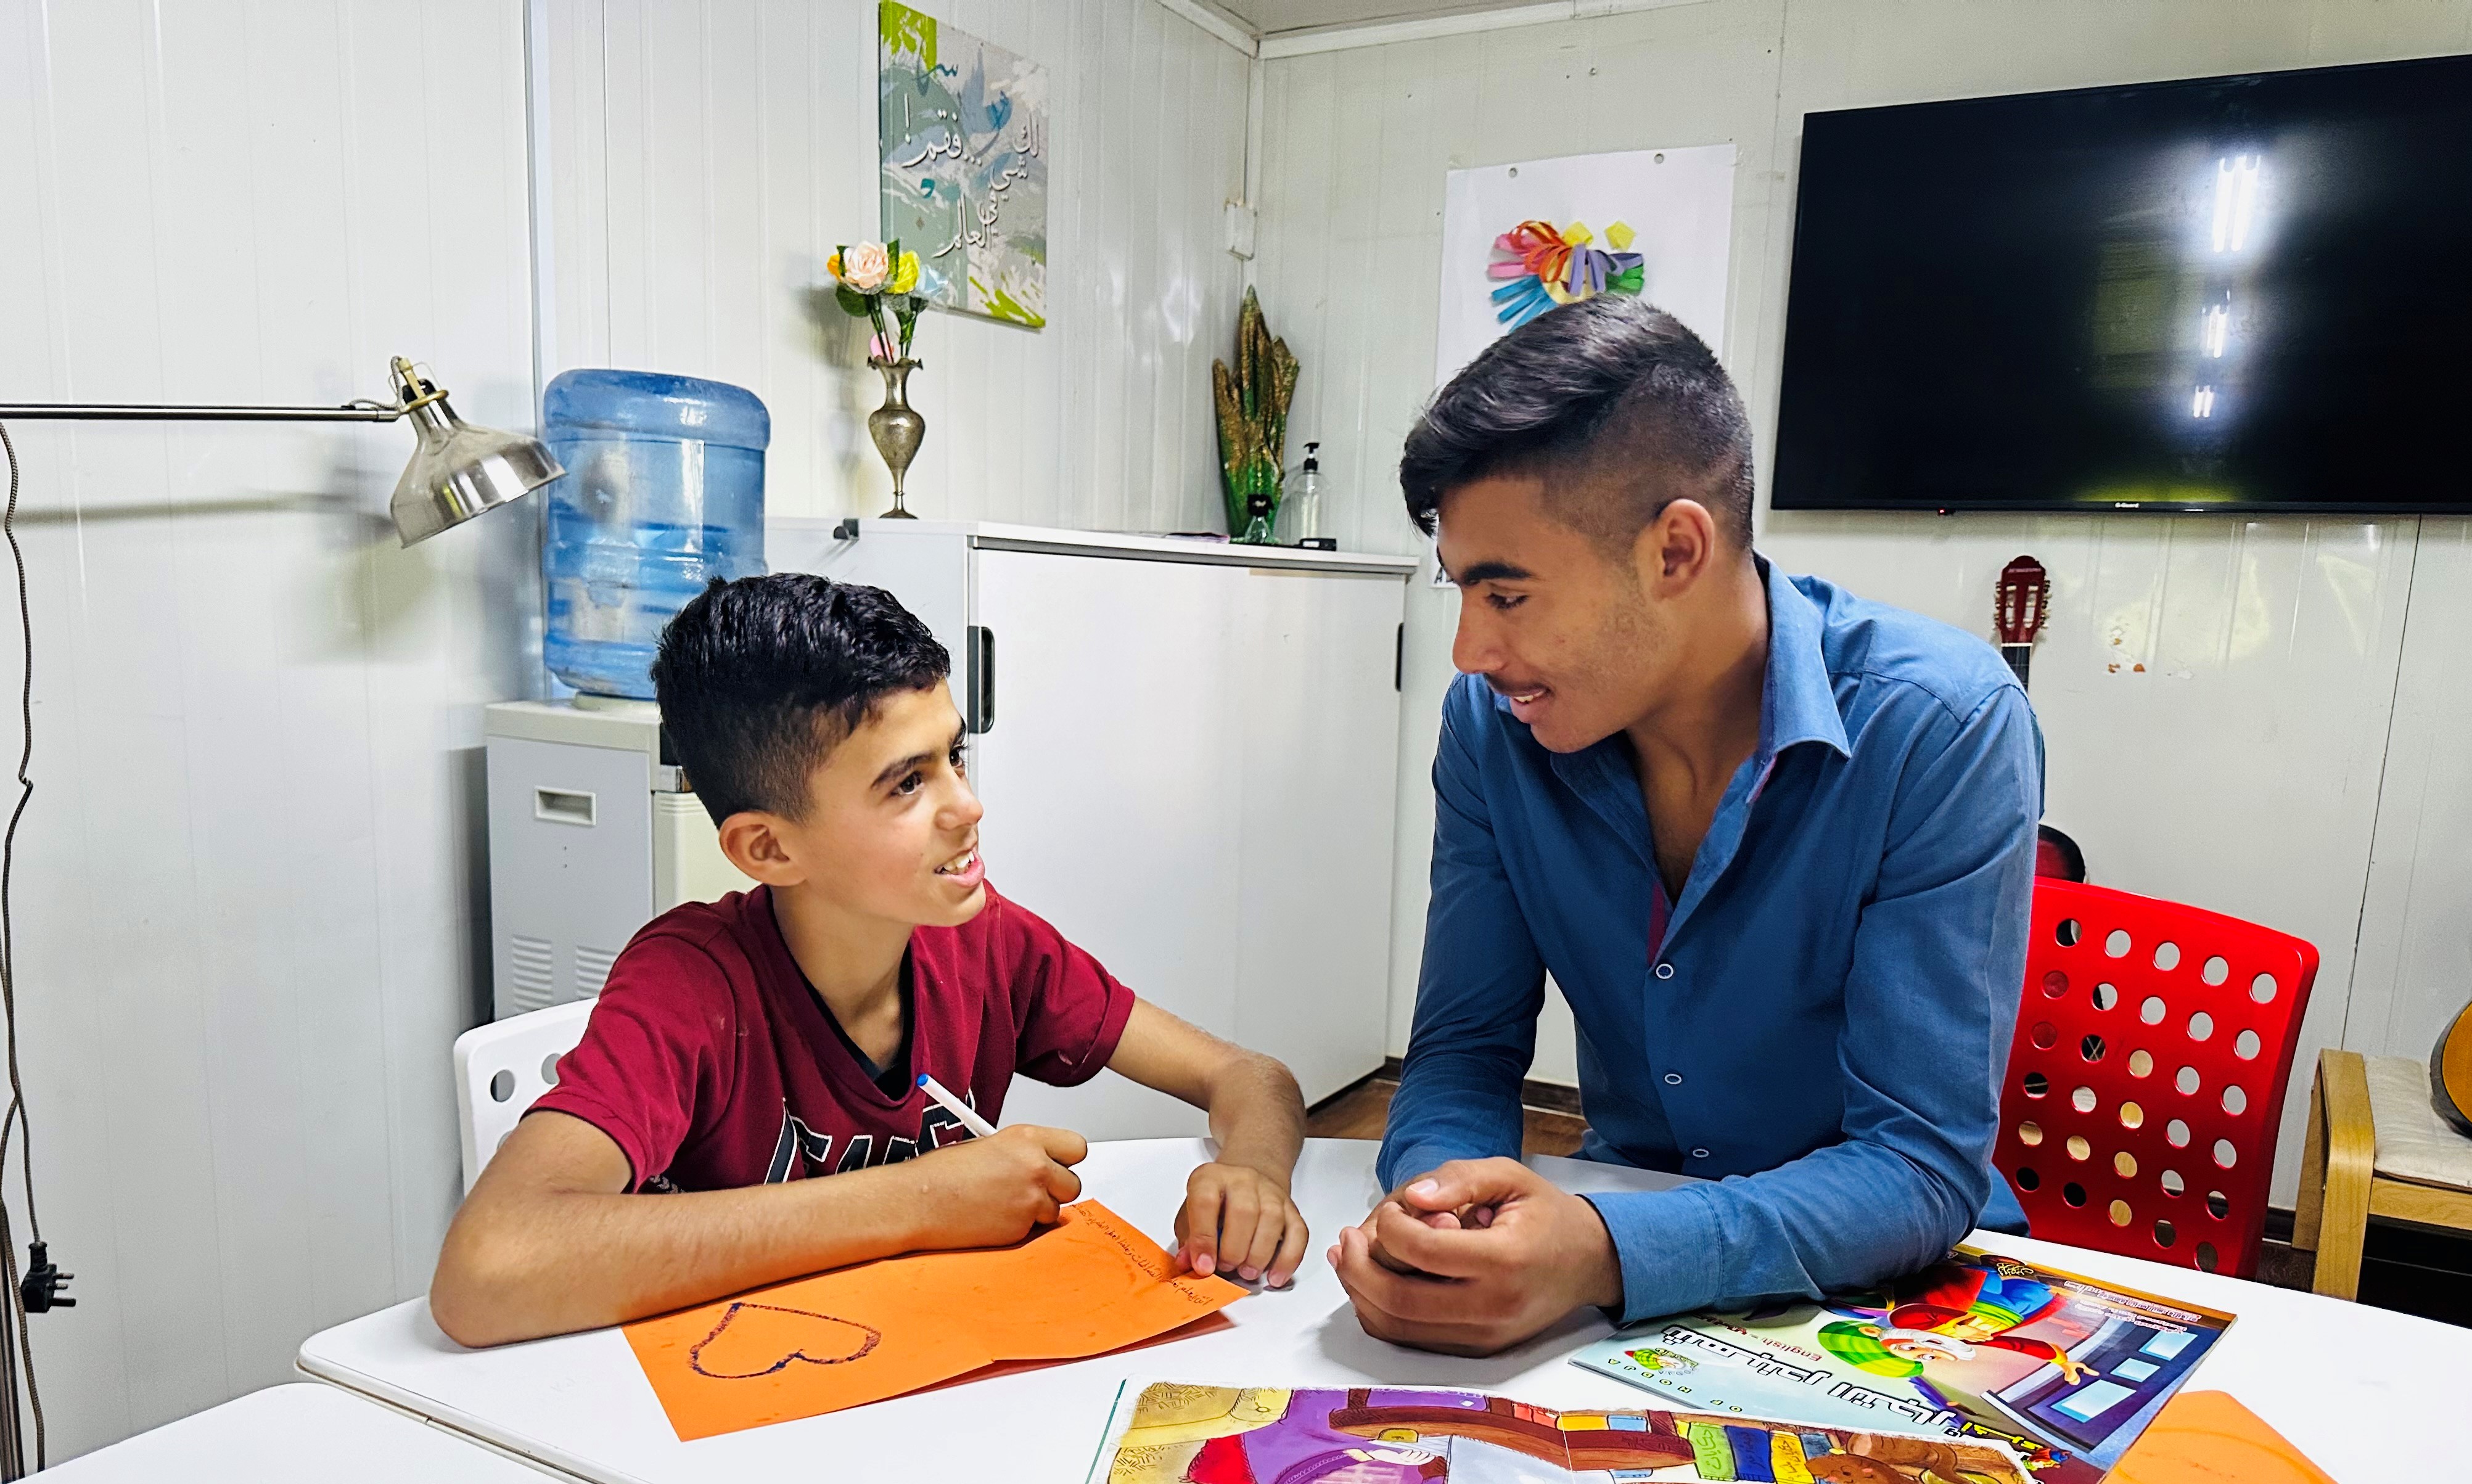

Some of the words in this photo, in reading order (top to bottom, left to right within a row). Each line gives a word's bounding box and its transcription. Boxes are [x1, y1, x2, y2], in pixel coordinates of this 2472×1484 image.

[932, 192, 992, 259] العالم
[1763, 1336, 1823, 1362] English
[1608, 1358, 1692, 1394] HODJA
[1662, 1324, 1832, 1386] شهبندر
[1827, 1380, 1958, 1428] التجار
